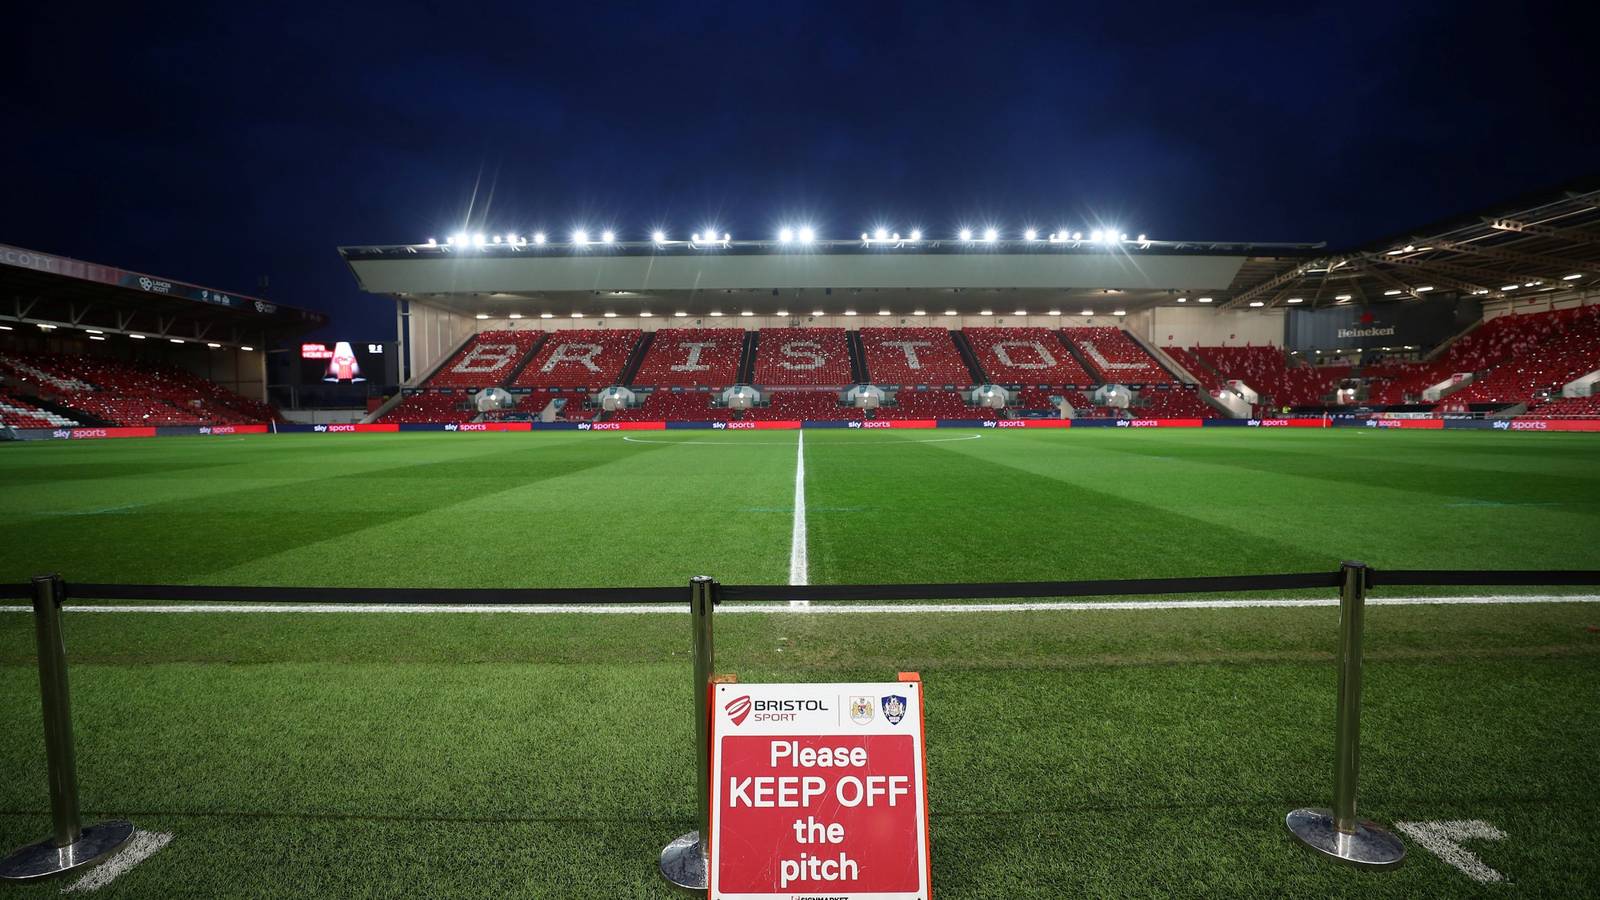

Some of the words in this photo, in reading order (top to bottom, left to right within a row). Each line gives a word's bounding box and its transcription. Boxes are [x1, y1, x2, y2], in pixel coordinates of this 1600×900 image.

[0, 250, 51, 270] COTT
[1338, 328, 1394, 338] Heineken
[451, 341, 1150, 373] BRISTOL
[444, 423, 458, 431] sky
[459, 423, 486, 431] sports
[578, 422, 591, 430] sky
[593, 422, 619, 430] sports
[712, 421, 726, 429] sky
[728, 421, 755, 429] sports
[848, 421, 861, 429] sky
[863, 421, 890, 429] sports
[983, 420, 996, 428] sky
[998, 420, 1025, 428] sports
[1116, 420, 1129, 428] sky
[1131, 420, 1157, 428] sports
[1247, 419, 1260, 427] sky
[1262, 419, 1287, 427] sports
[1366, 419, 1378, 427] sky
[1493, 421, 1509, 430] sky
[1512, 421, 1547, 430] sports
[199, 426, 211, 434] sky
[212, 425, 235, 433] sports
[314, 424, 327, 432] sky
[329, 424, 355, 432] sports
[53, 429, 70, 438] sky
[73, 428, 107, 438] sports
[754, 700, 829, 711] BRISTOL
[754, 713, 797, 722] SPORT
[770, 740, 867, 768] Please
[729, 776, 826, 808] KEEP
[836, 775, 909, 807] OFF
[793, 816, 845, 844] the
[780, 852, 858, 889] pitch
